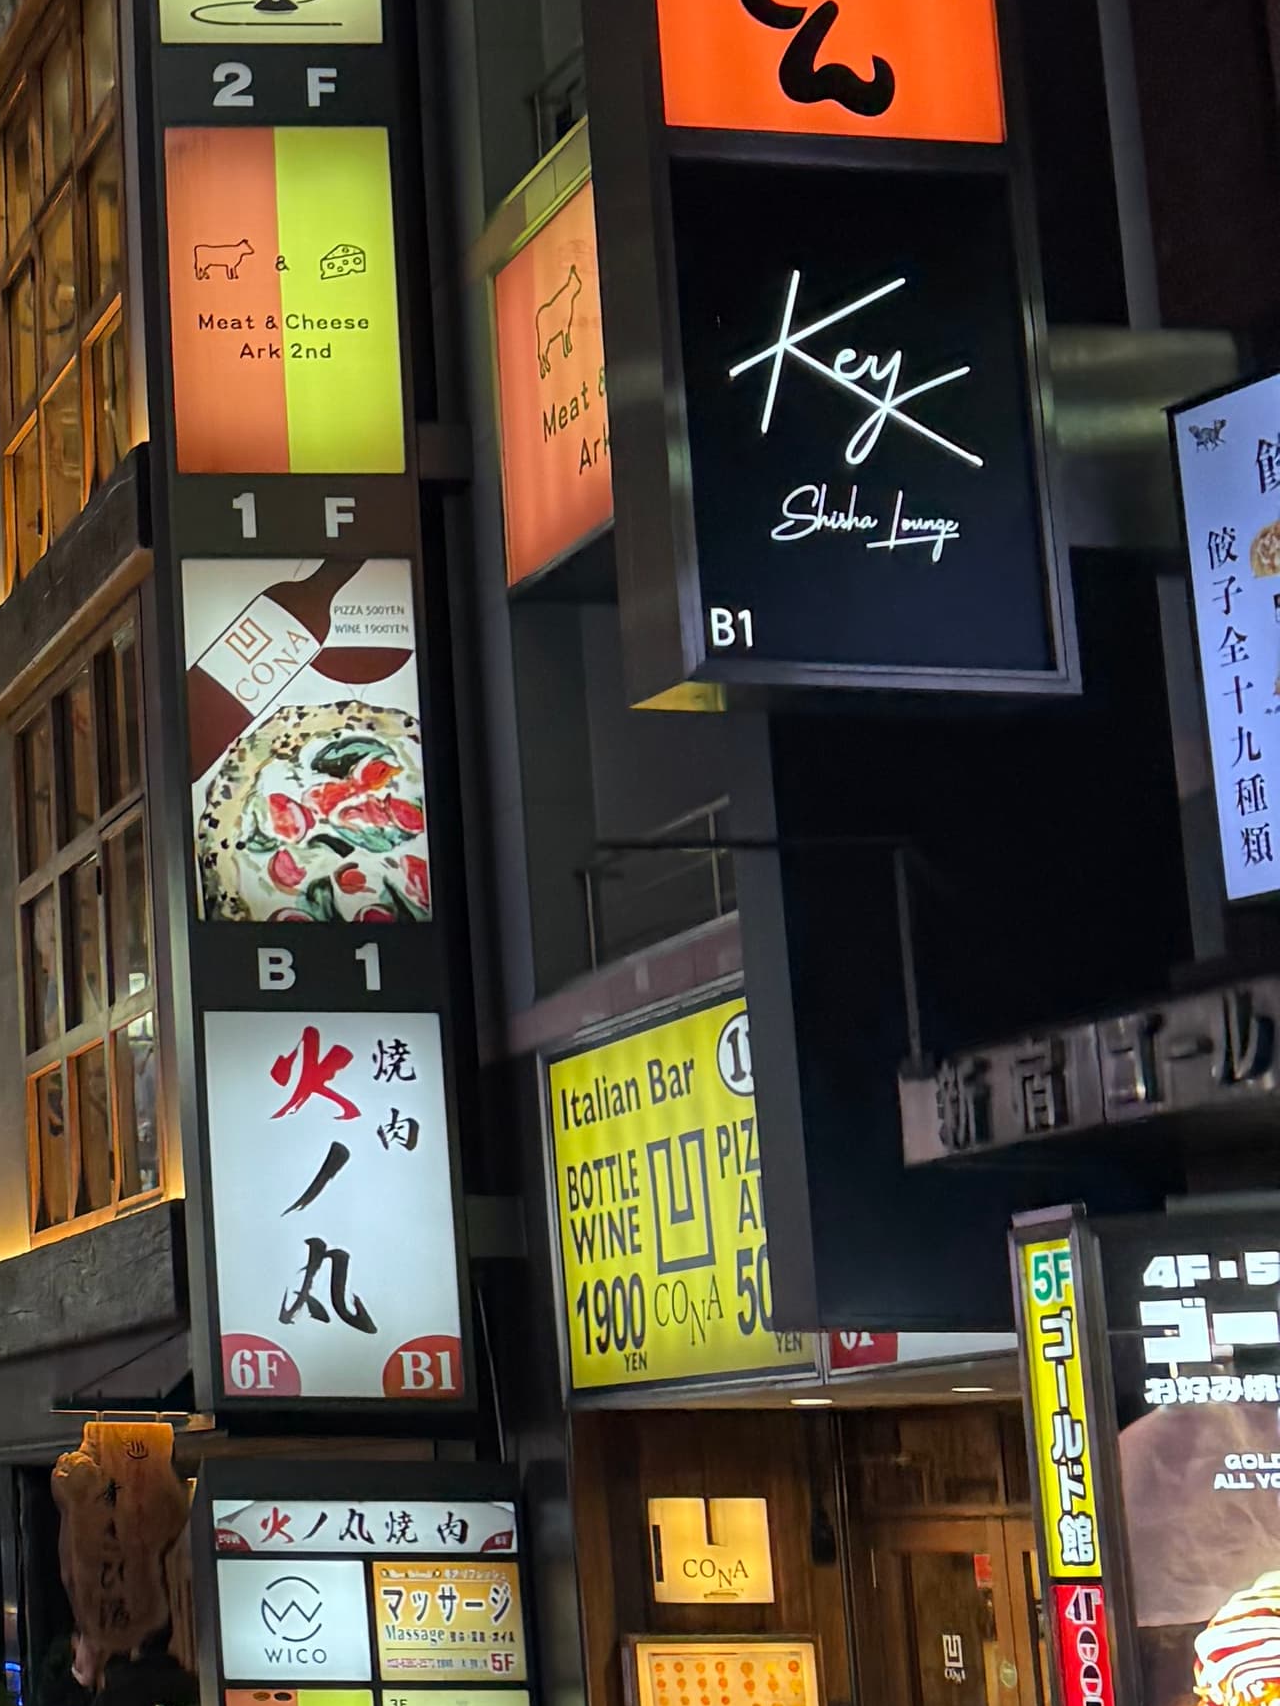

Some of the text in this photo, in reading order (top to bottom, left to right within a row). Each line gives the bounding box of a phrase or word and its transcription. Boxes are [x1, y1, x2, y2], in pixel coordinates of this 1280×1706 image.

[198, 313, 370, 331] Meat & Cheese
[239, 342, 333, 360] Ark 2nd
[543, 383, 590, 443] Meat
[772, 483, 960, 563] Shisha Lounge
[334, 605, 363, 615] PIZZA
[334, 624, 361, 634] WINE
[710, 606, 754, 649] B1
[235, 627, 312, 704] CONA
[1207, 526, 1273, 868] 餃子全十九種類
[371, 1037, 421, 1155] 焼肉
[561, 1057, 694, 1131] Italian Bar
[268, 1025, 378, 1335] 火ノ丸
[567, 1149, 639, 1213] BOTTLE
[571, 1205, 642, 1264] WINE
[1033, 1251, 1071, 1302] 5F
[577, 1272, 646, 1355] 1900
[654, 1274, 724, 1347] CONA
[229, 1349, 286, 1392] 6F
[399, 1351, 456, 1392] B1
[624, 1352, 647, 1371] YEN
[1040, 1309, 1095, 1564] ゴールド館
[1214, 1473, 1254, 1489] ALL
[683, 1558, 749, 1589] CONA
[381, 1584, 510, 1624] マッサージ
[265, 1648, 328, 1665] WICO
[385, 1625, 445, 1646] Massage
[490, 1653, 515, 1671] 5F
